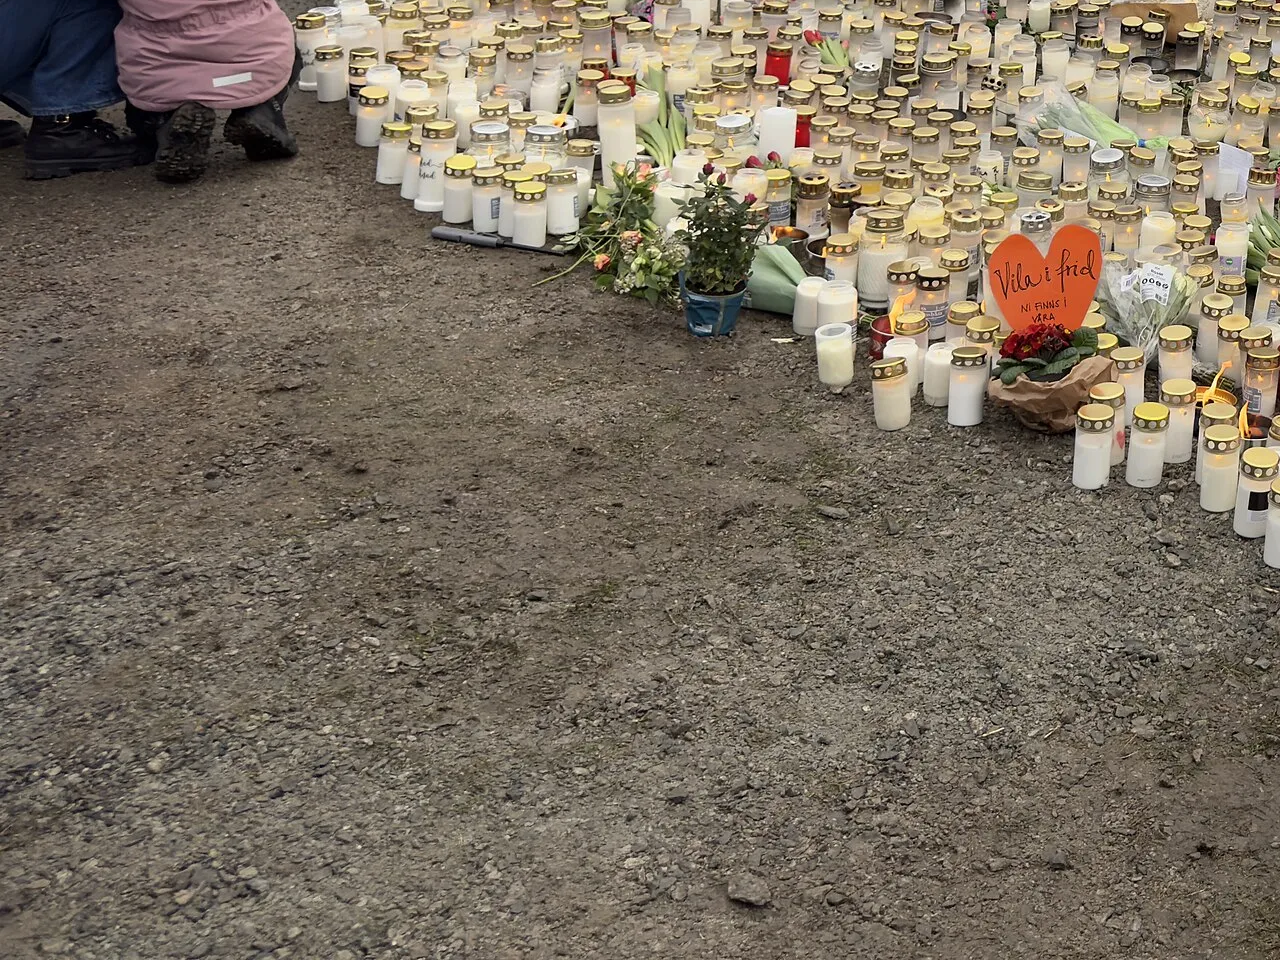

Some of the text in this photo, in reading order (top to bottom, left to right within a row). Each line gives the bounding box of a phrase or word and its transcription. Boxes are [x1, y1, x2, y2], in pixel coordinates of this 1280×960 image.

[994, 248, 1097, 299] Vila i frid
[1034, 299, 1060, 311] FINNS
[1031, 312, 1056, 324] VÅRA
